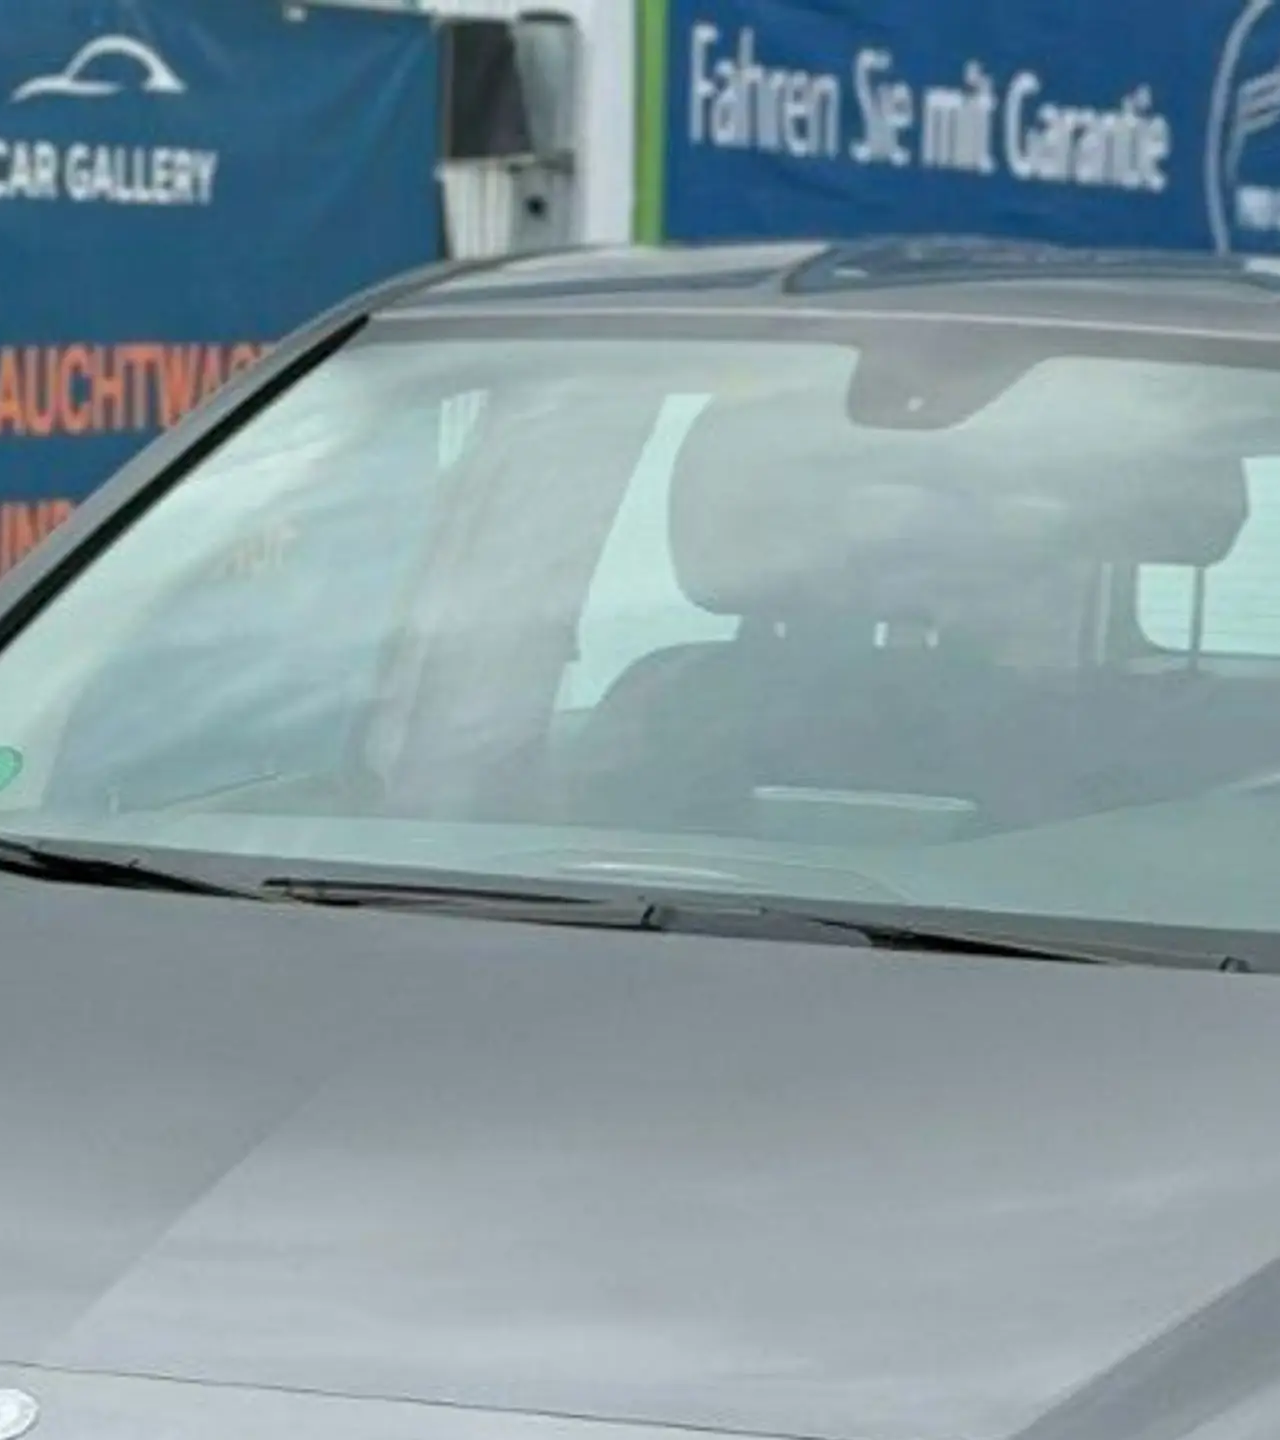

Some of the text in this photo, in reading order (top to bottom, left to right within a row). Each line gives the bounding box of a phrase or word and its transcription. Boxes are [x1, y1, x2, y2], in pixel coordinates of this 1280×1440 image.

[689, 22, 1170, 194] Fahren Sie mit Garantie
[65, 140, 218, 206] GALLERY
